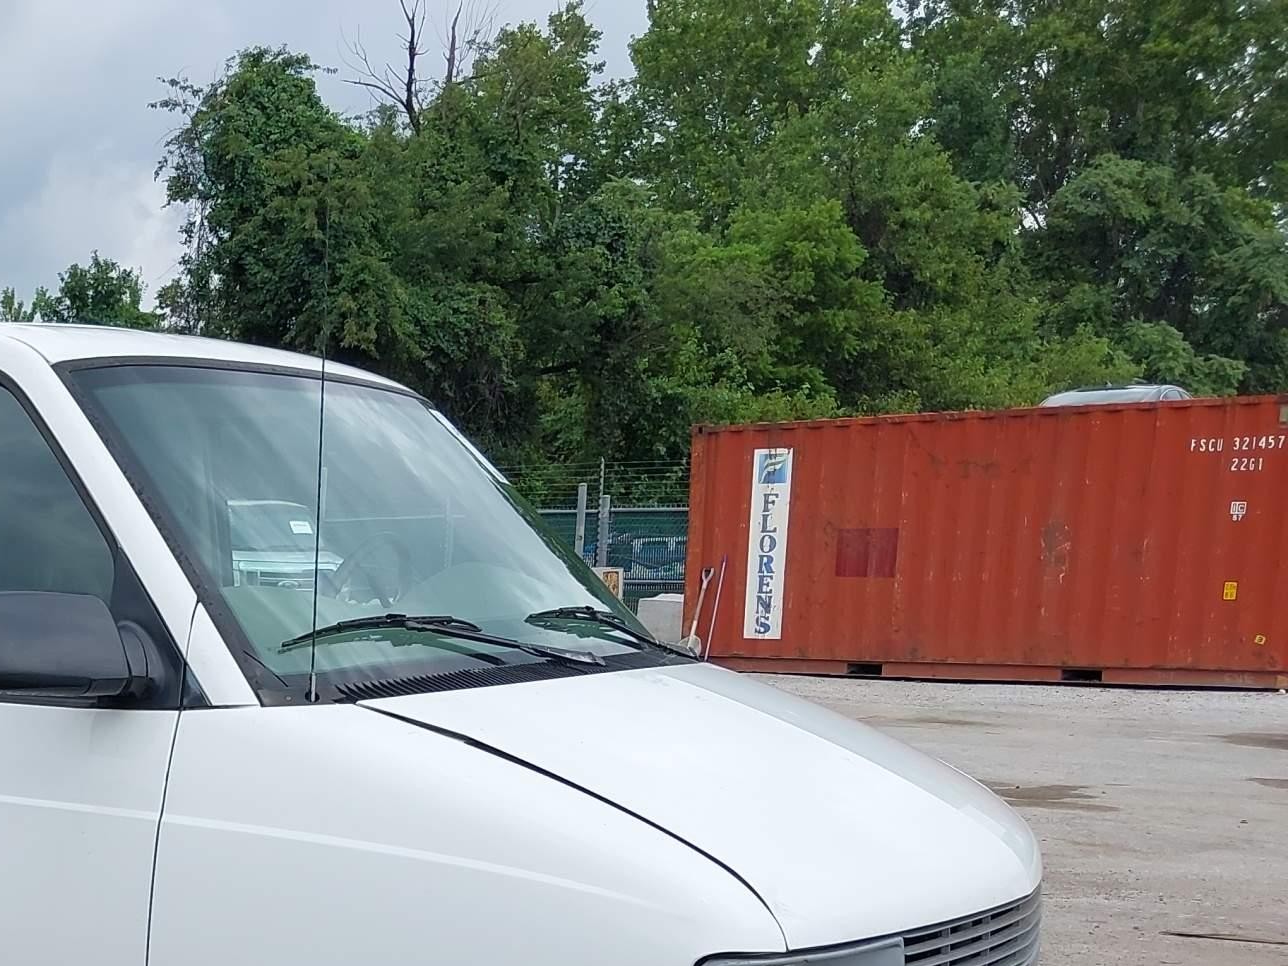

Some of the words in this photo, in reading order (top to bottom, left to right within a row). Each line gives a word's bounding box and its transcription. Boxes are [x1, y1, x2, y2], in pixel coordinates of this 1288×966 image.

[1190, 439, 1223, 452] FSCU
[1233, 436, 1286, 450] 321457
[1231, 458, 1263, 471] 22G1
[754, 493, 779, 635] FLORENS
